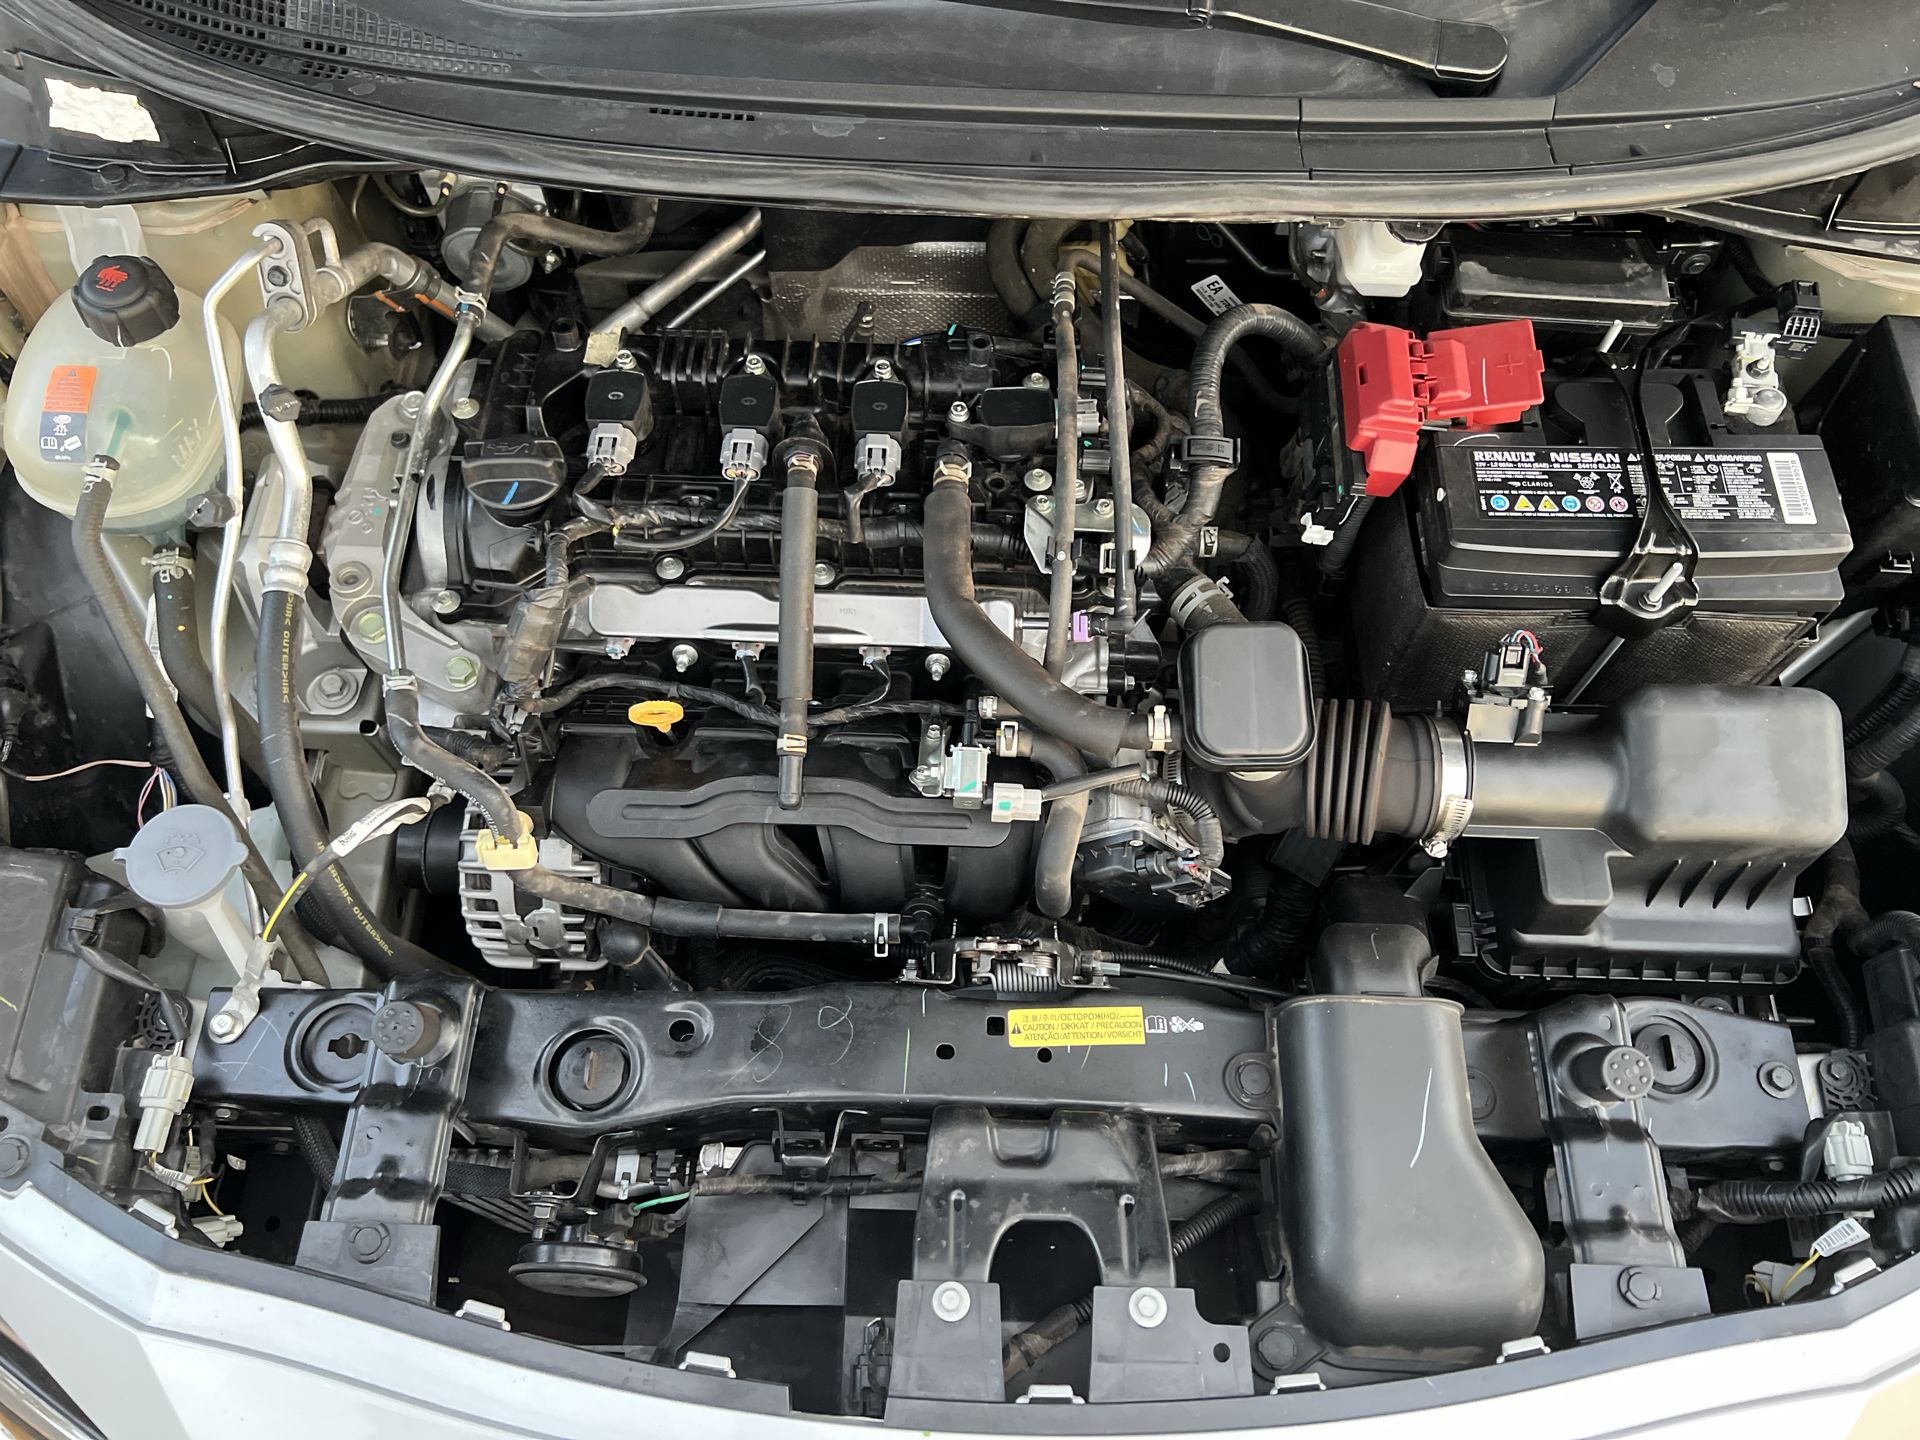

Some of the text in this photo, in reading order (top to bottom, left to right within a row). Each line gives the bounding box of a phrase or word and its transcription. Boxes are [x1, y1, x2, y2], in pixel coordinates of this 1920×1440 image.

[1473, 451, 1536, 462] RENAULT
[1550, 452, 1620, 463] NISSAN
[1022, 1023, 1055, 1031] CAUTION
[1060, 1021, 1089, 1031] DIKKAT
